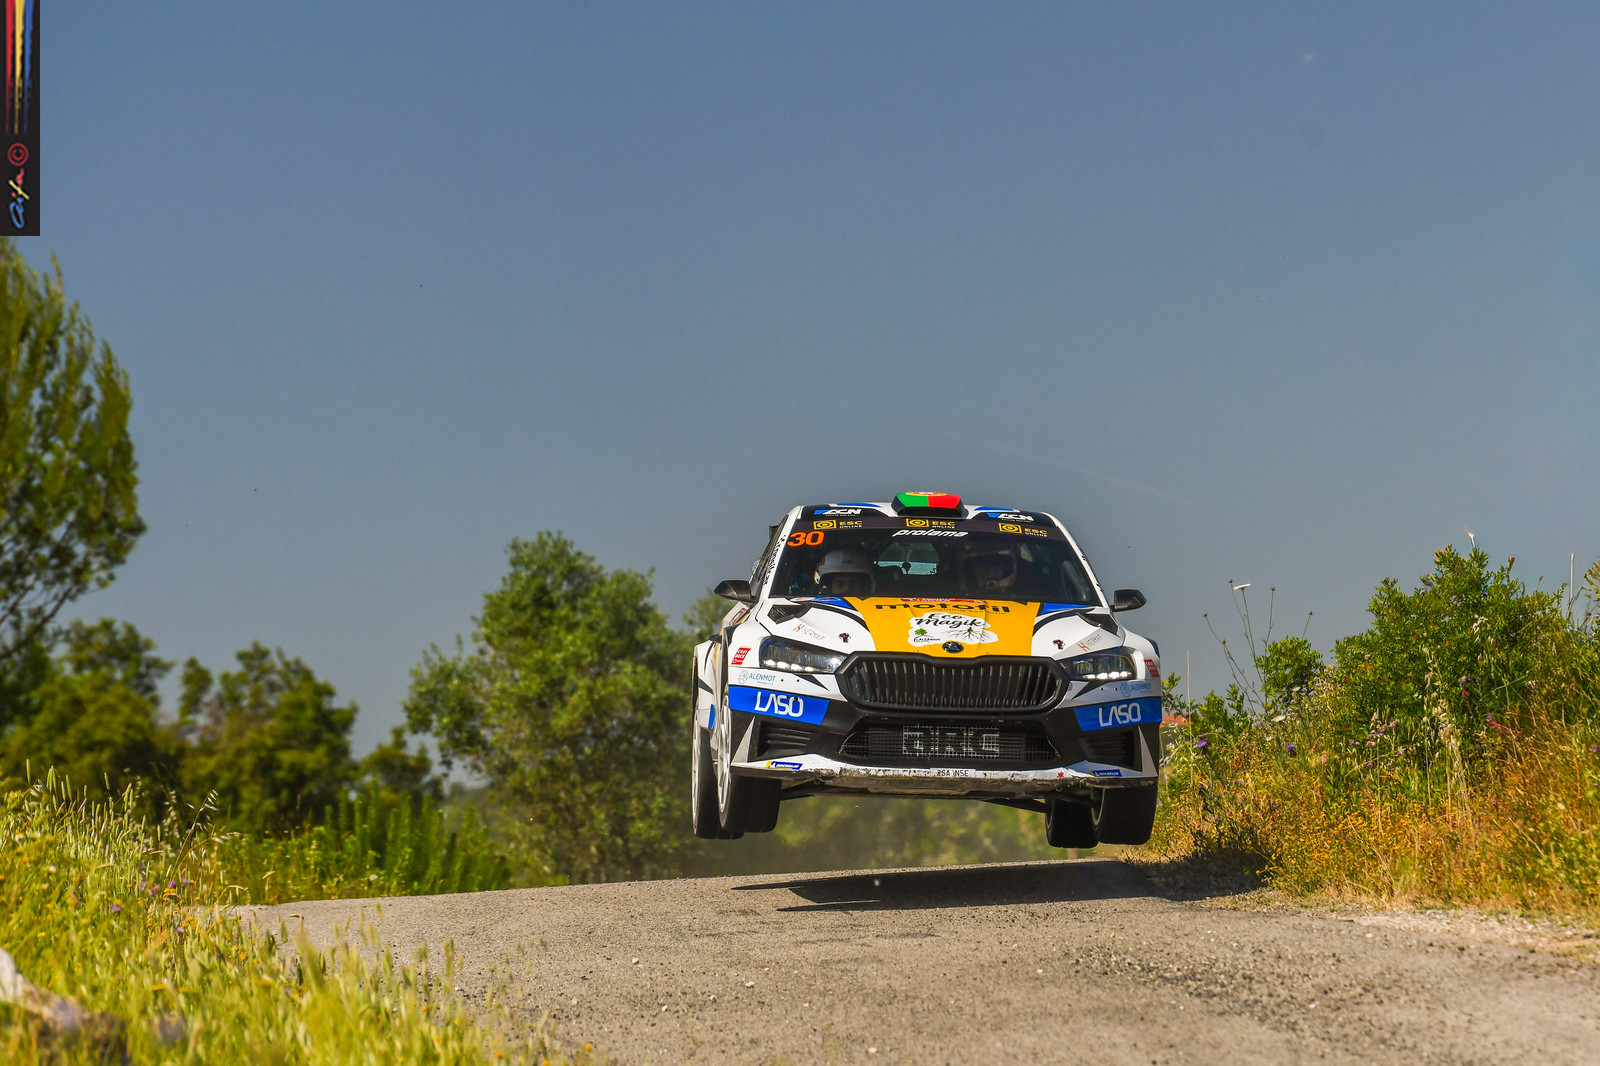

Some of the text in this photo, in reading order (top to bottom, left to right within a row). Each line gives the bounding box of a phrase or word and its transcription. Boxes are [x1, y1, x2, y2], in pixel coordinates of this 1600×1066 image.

[787, 531, 825, 547] 30
[891, 529, 969, 538] prolama
[875, 603, 1010, 613] motofil
[914, 618, 986, 629] Magik
[749, 673, 777, 682] ALENMOT
[754, 691, 804, 717] LASO
[1098, 702, 1142, 727] LASO
